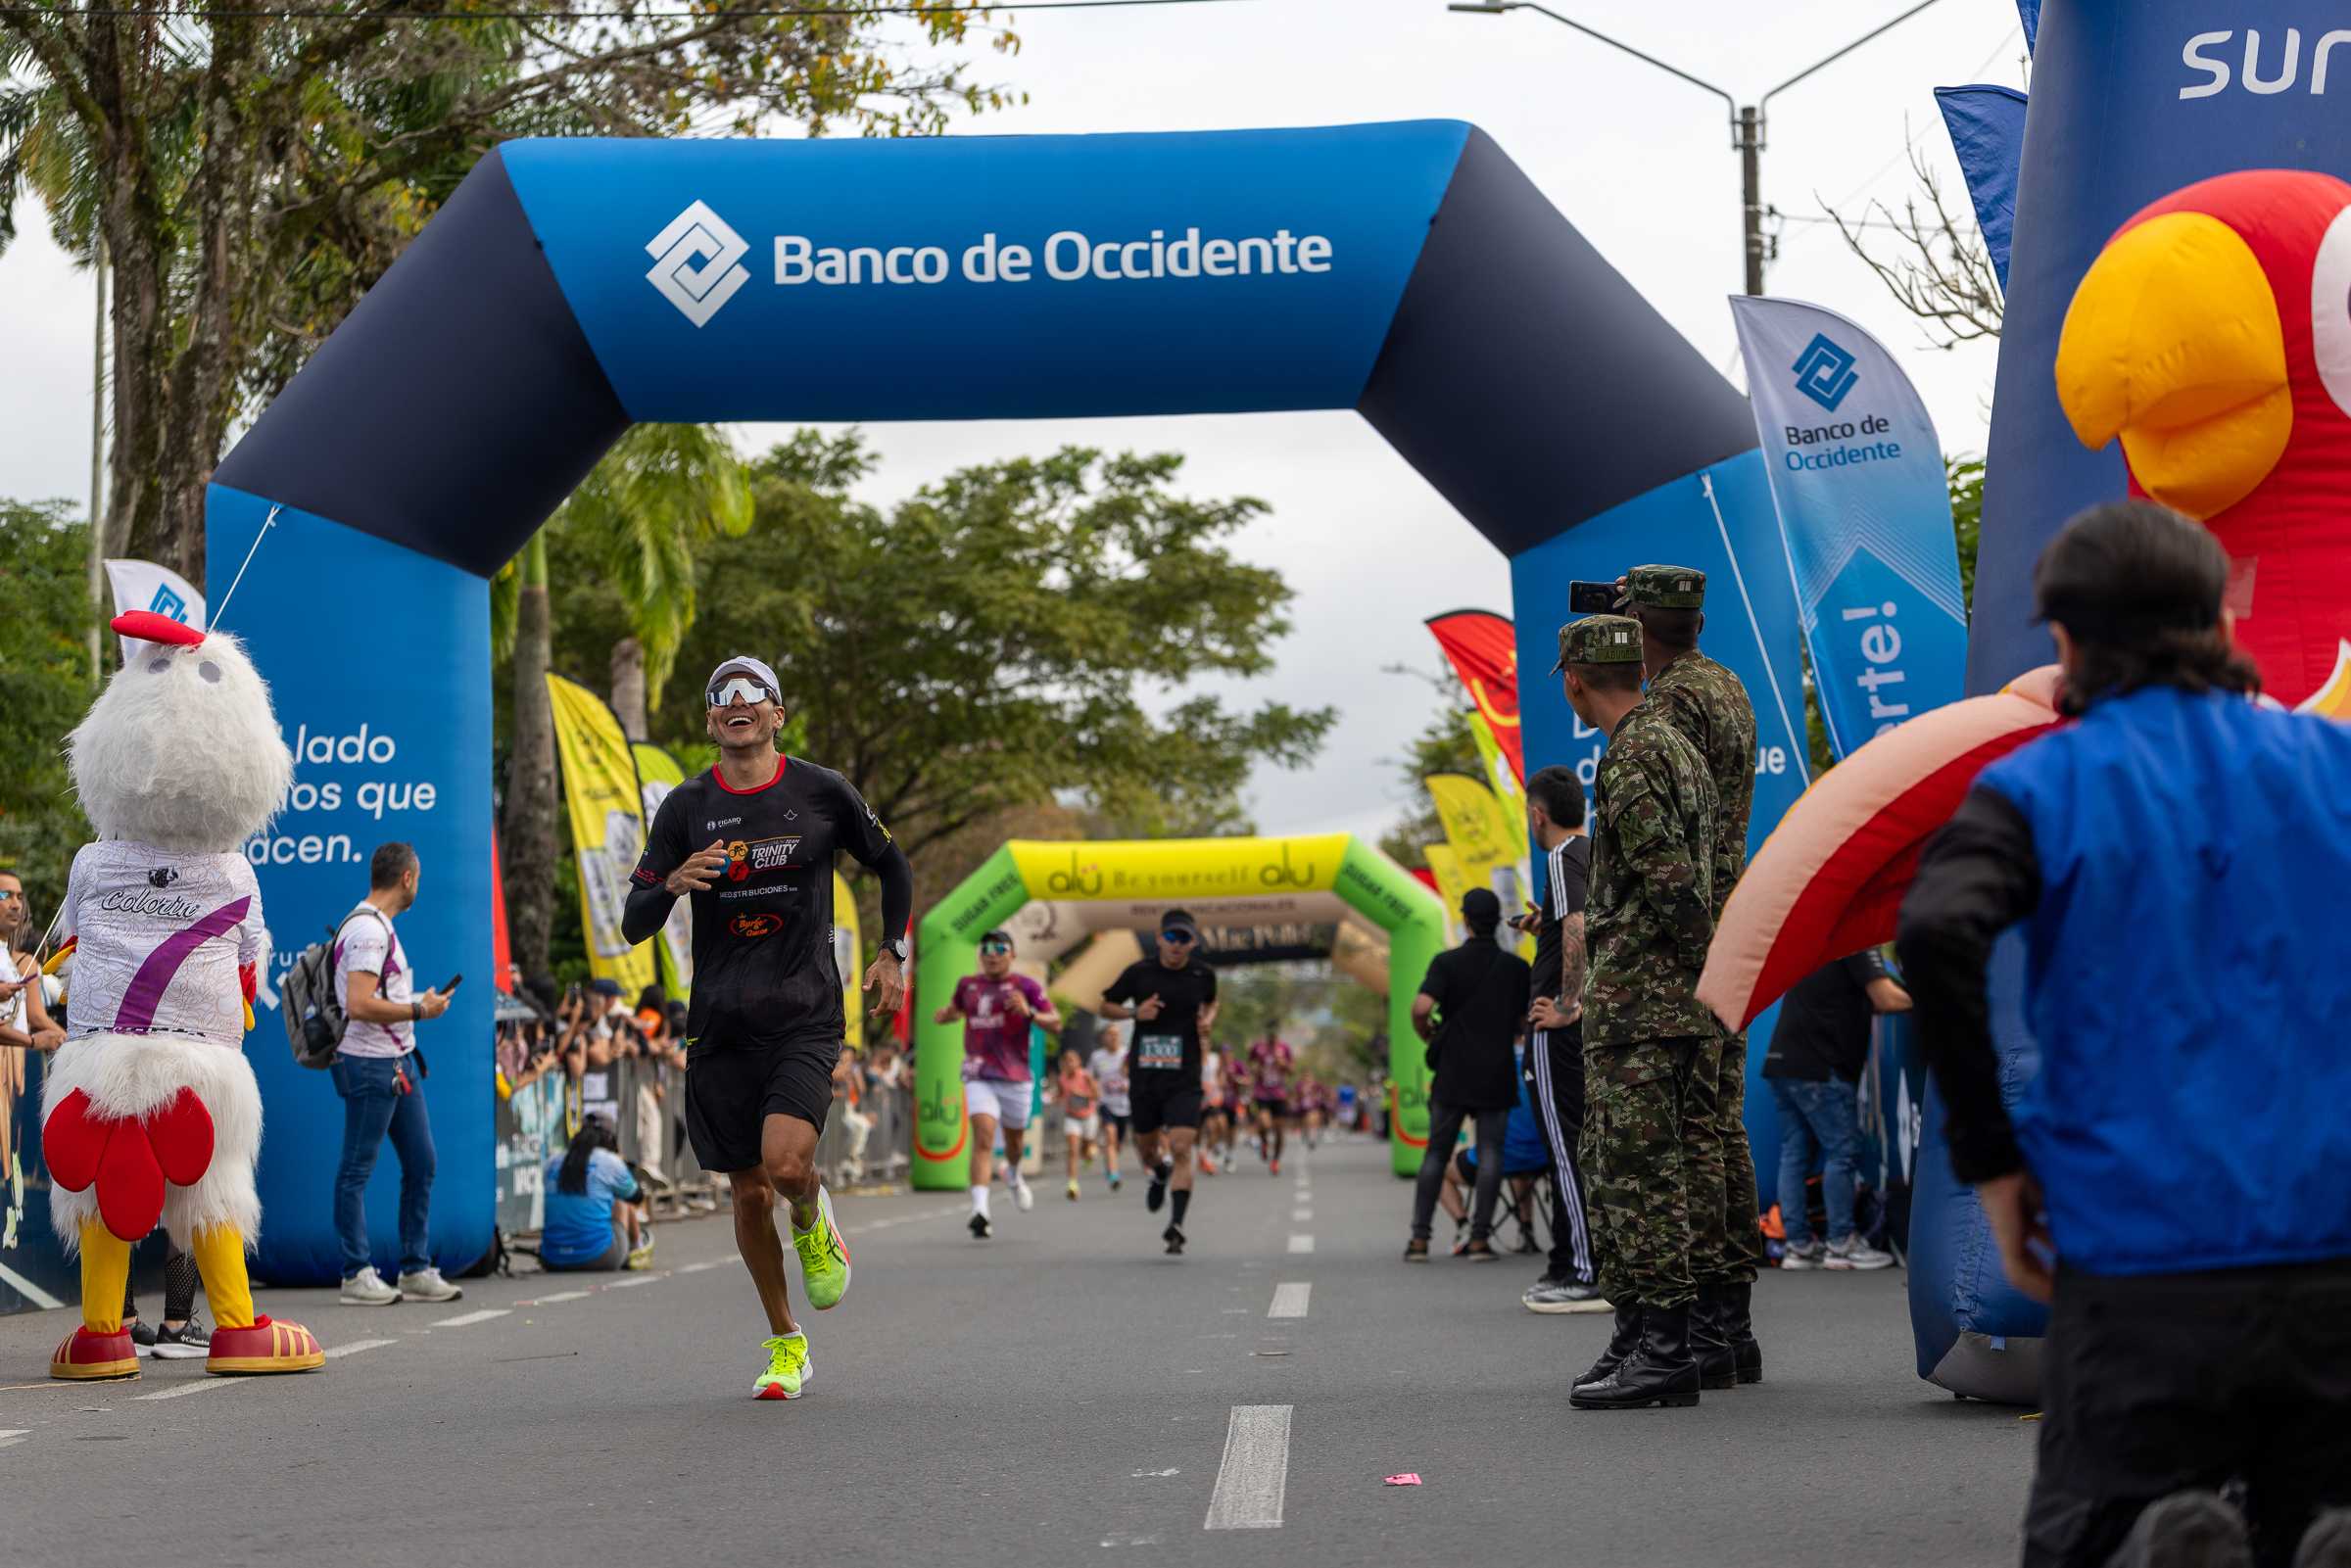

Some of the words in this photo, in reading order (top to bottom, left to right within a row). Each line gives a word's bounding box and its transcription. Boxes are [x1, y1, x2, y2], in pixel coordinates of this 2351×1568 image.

[773, 235, 950, 286] Banco
[962, 232, 1032, 283] de
[1044, 227, 1333, 282] Occidente
[1786, 422, 1855, 446] Banco
[1860, 413, 1890, 436] de
[1786, 442, 1900, 471] Occidente
[296, 723, 396, 764] lado
[357, 782, 437, 821] que
[242, 833, 362, 866] acen.
[752, 843, 797, 860] TRINITY
[754, 854, 789, 870] CLUB
